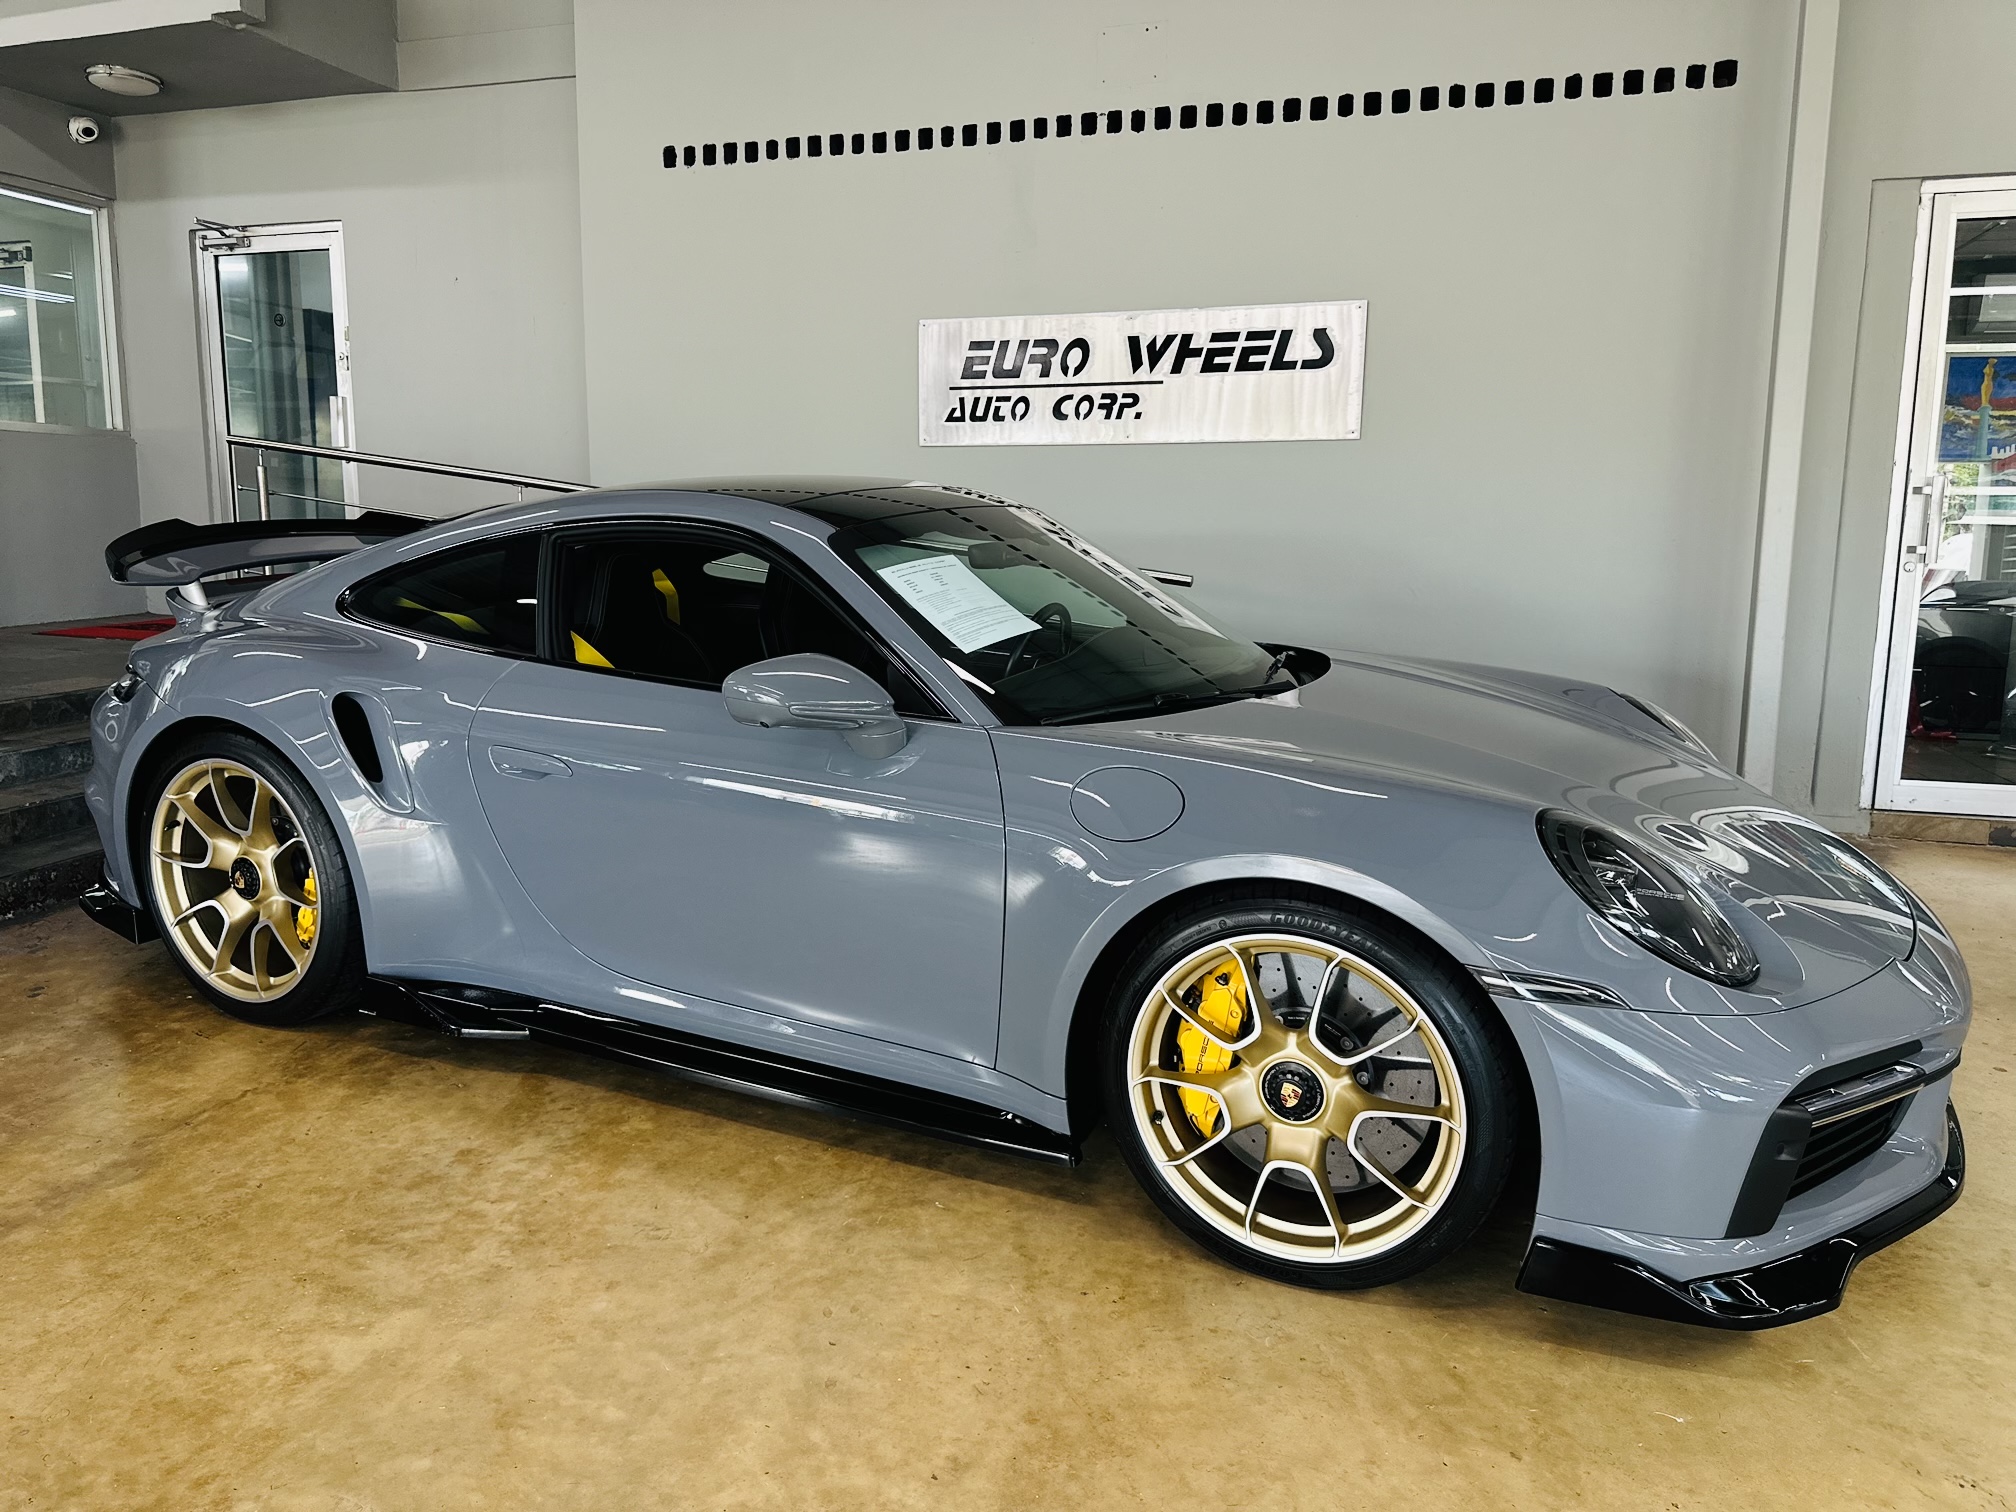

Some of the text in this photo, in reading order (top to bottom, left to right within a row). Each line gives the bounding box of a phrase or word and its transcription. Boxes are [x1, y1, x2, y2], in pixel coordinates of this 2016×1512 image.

[961, 327, 1335, 380] EURO WHEELS
[944, 392, 1143, 423] AUTO CORP.
